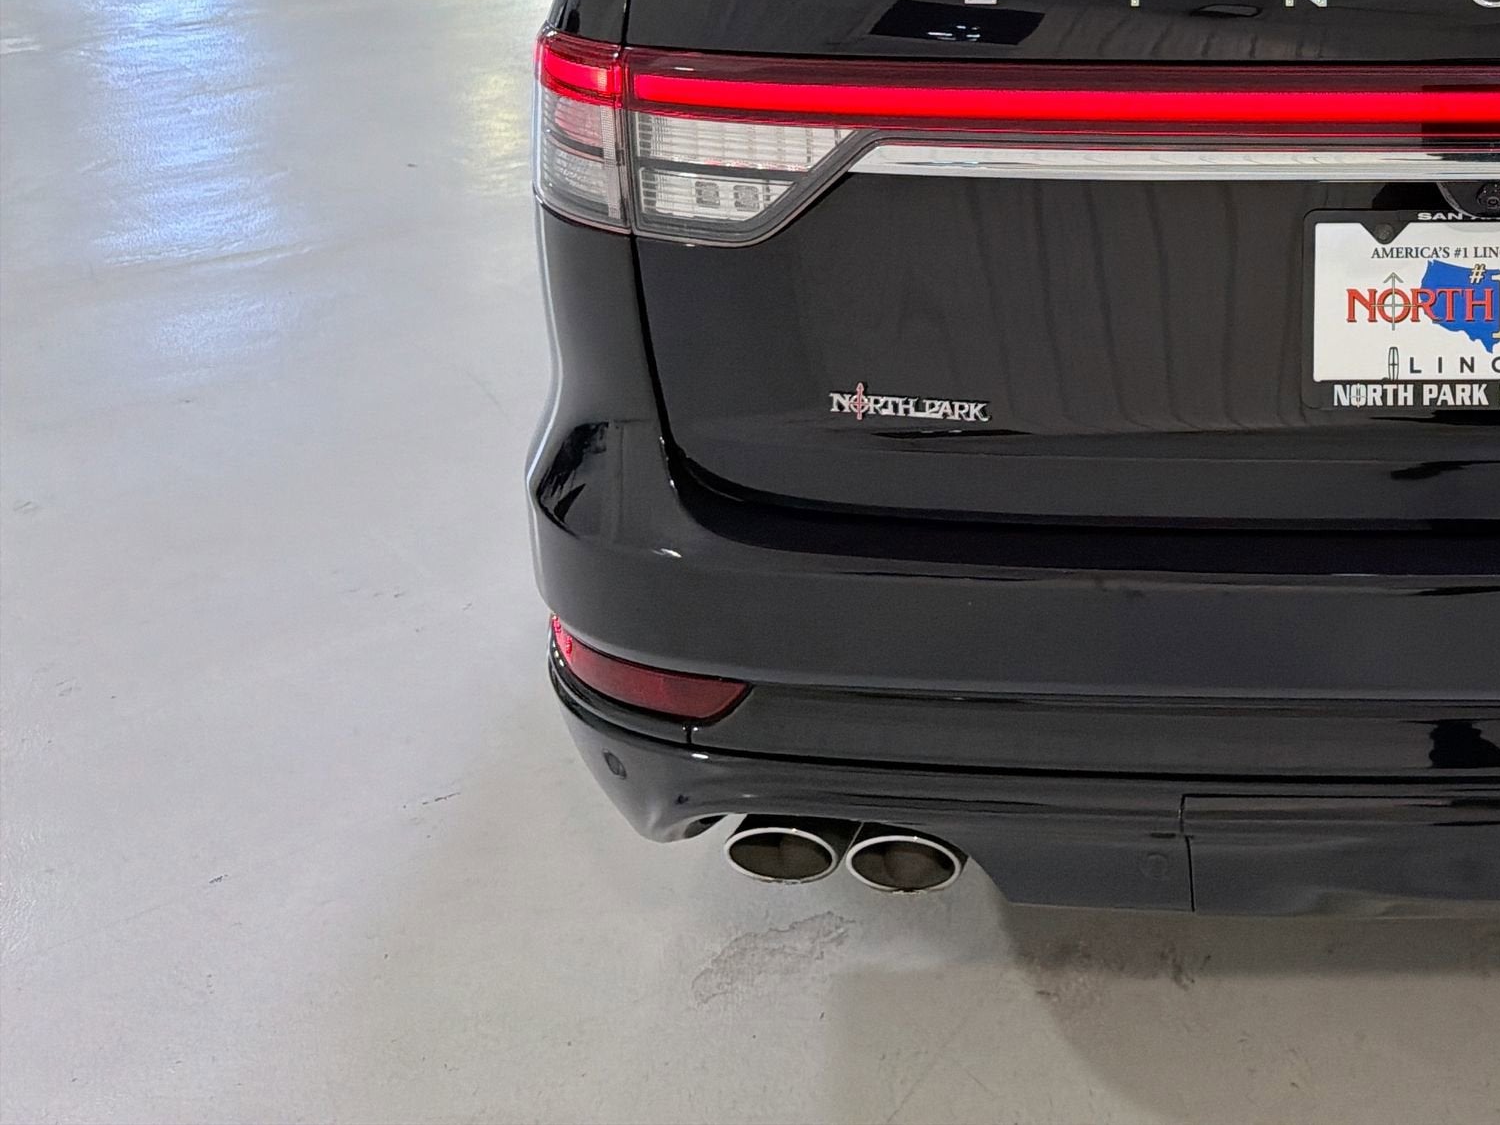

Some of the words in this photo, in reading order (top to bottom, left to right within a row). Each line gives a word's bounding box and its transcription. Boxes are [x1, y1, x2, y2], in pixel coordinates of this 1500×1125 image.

[1417, 211, 1463, 221] SAN
[1371, 246, 1450, 259] AMERICA'S
[1454, 246, 1469, 259] #1
[1346, 288, 1494, 323] NORTH
[829, 391, 917, 417] NORTH
[922, 399, 992, 422] PARK
[1333, 383, 1414, 408] NORTH
[1422, 384, 1489, 407] PARK
